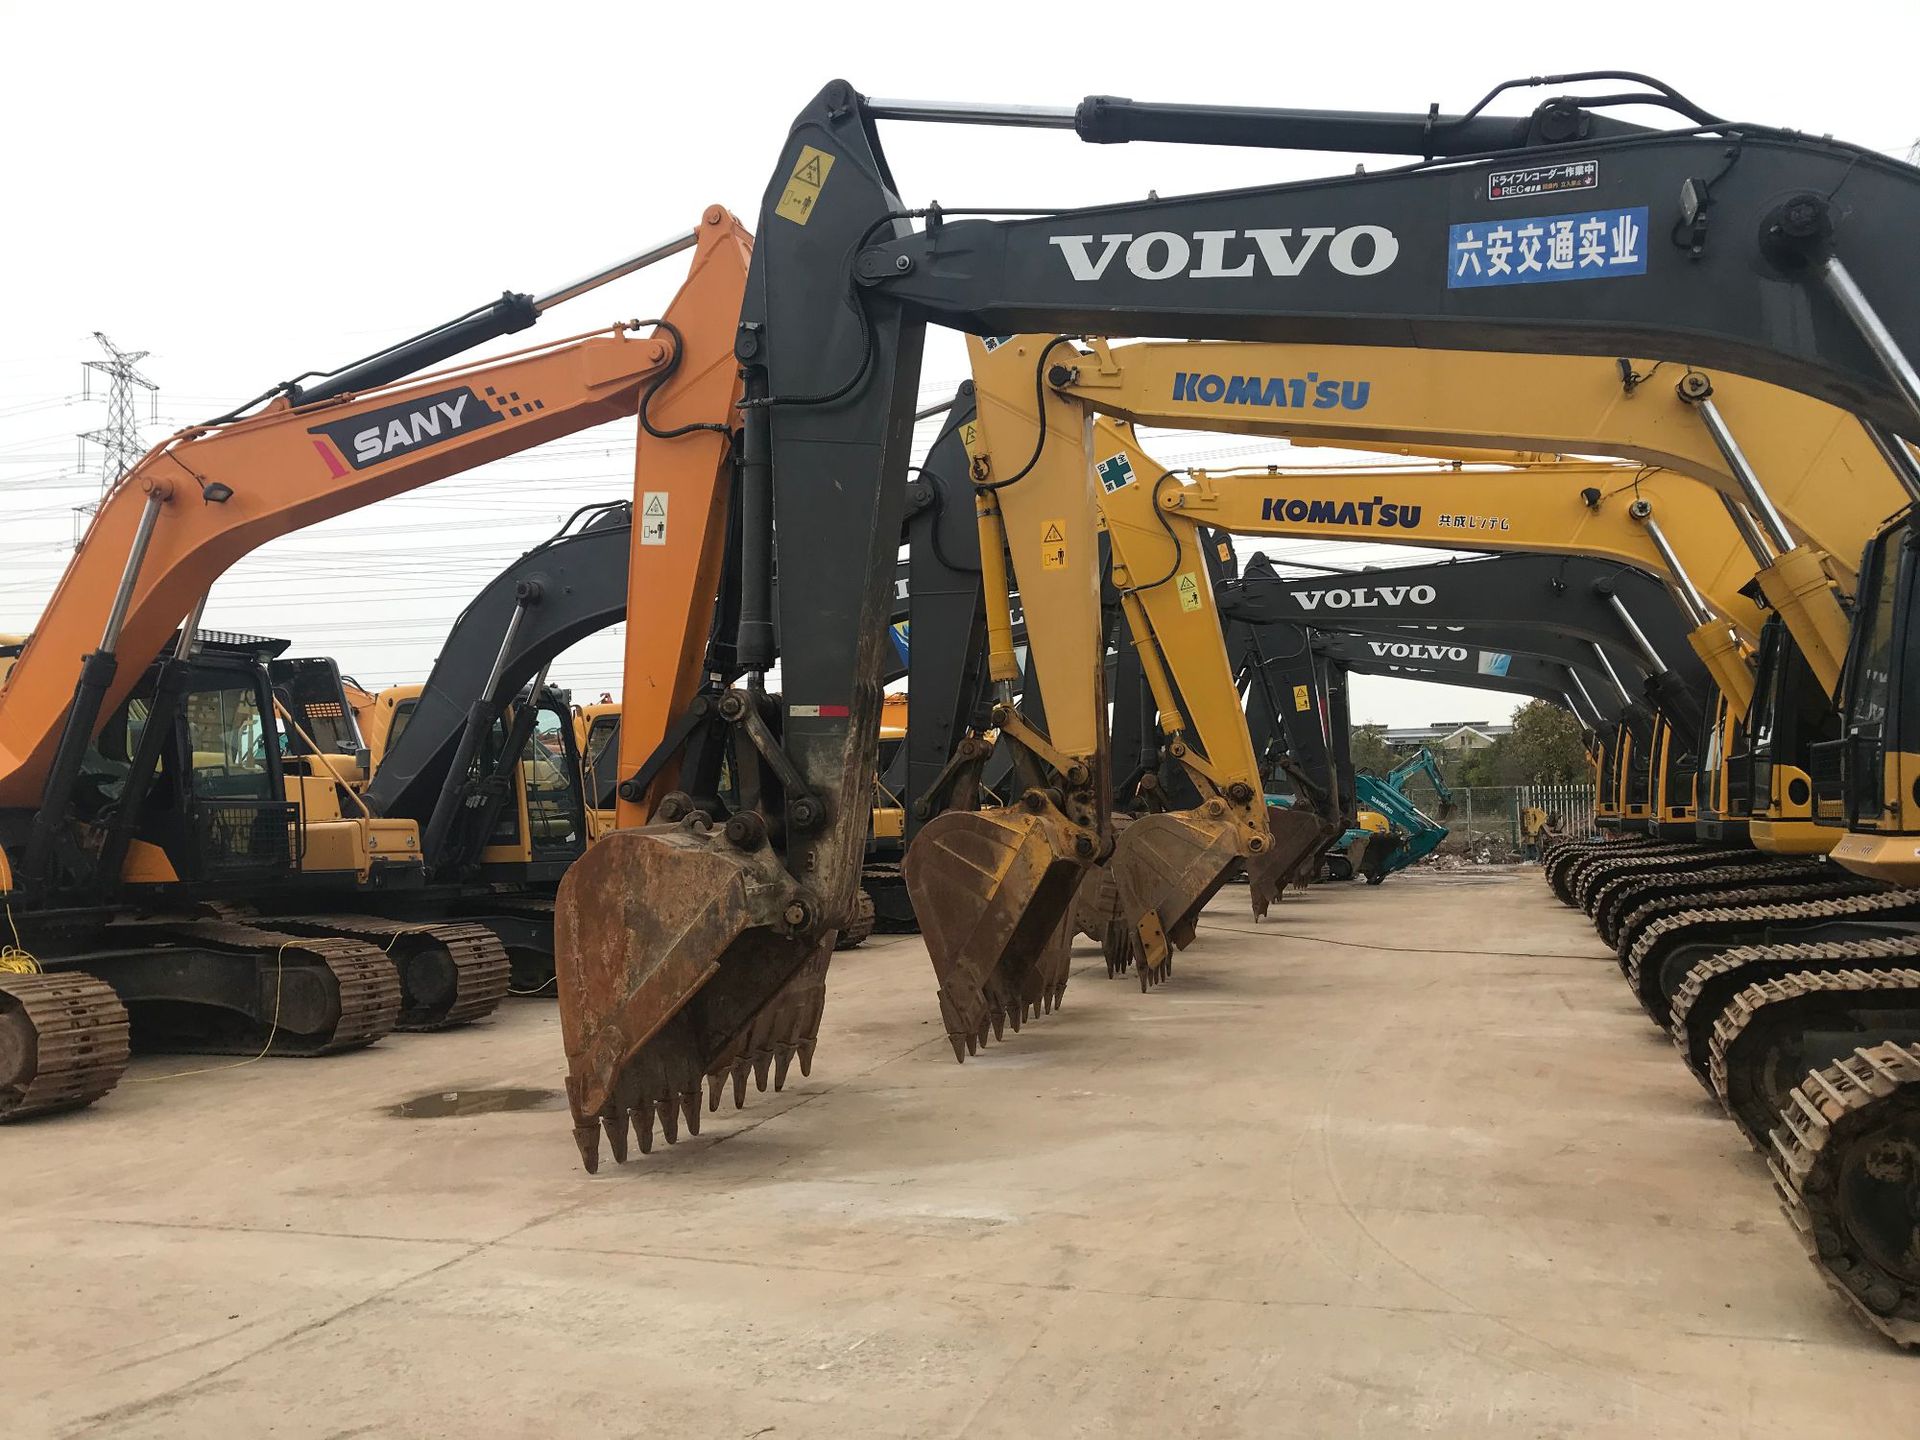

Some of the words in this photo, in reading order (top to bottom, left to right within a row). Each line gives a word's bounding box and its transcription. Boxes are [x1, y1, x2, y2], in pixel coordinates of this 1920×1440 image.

[1492, 164, 1595, 186] ドライブレコーダー作業中
[1502, 185, 1524, 195] REC
[1049, 225, 1398, 281] VOLVO
[1456, 215, 1639, 277] 六安交通实业
[1173, 372, 1370, 410] KOMATSU
[353, 394, 469, 463] SANY
[1262, 496, 1421, 529] KOMATSU
[1291, 585, 1437, 610] VOLVO
[1367, 642, 1468, 661] VOLVO
